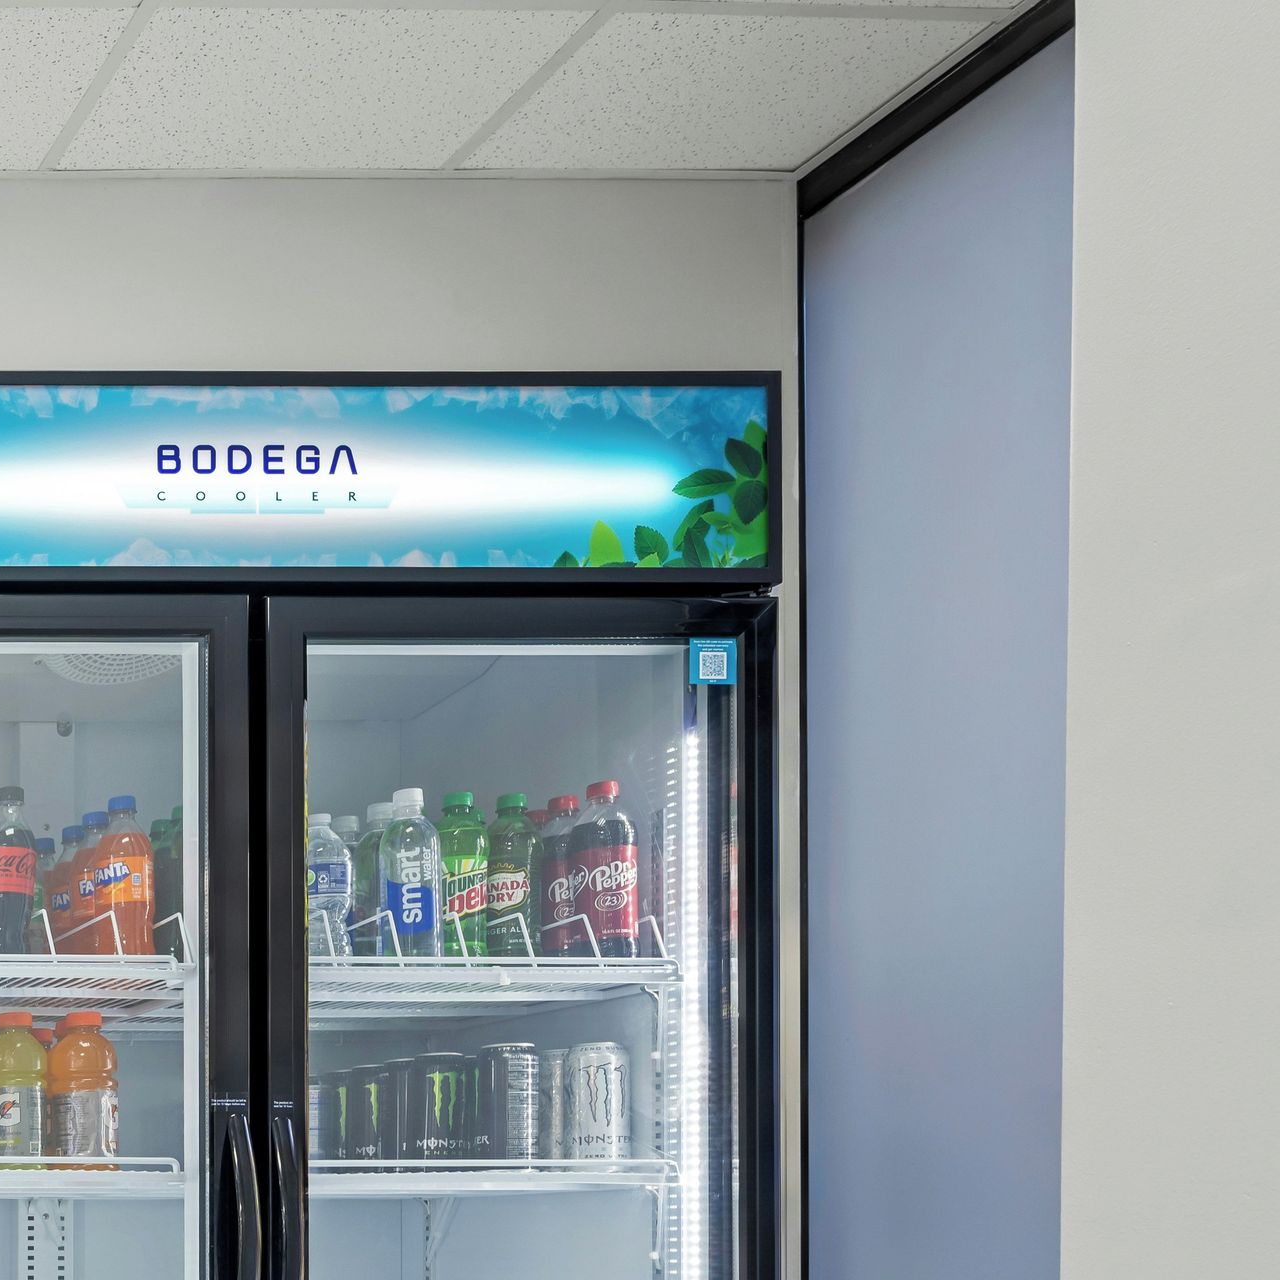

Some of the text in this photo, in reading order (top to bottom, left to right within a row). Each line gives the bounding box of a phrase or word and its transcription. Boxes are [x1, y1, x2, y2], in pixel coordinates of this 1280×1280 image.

[157, 444, 358, 475] BODEGA
[157, 491, 358, 502] COOLER
[422, 847, 432, 880] water
[610, 861, 631, 876] Dr
[95, 862, 130, 883] FANTA
[595, 865, 637, 891] Pepper
[397, 847, 422, 924] smart
[488, 879, 530, 892] NADA
[52, 891, 71, 908] FAN
[488, 892, 515, 903] DRY
[604, 895, 618, 905] 23
